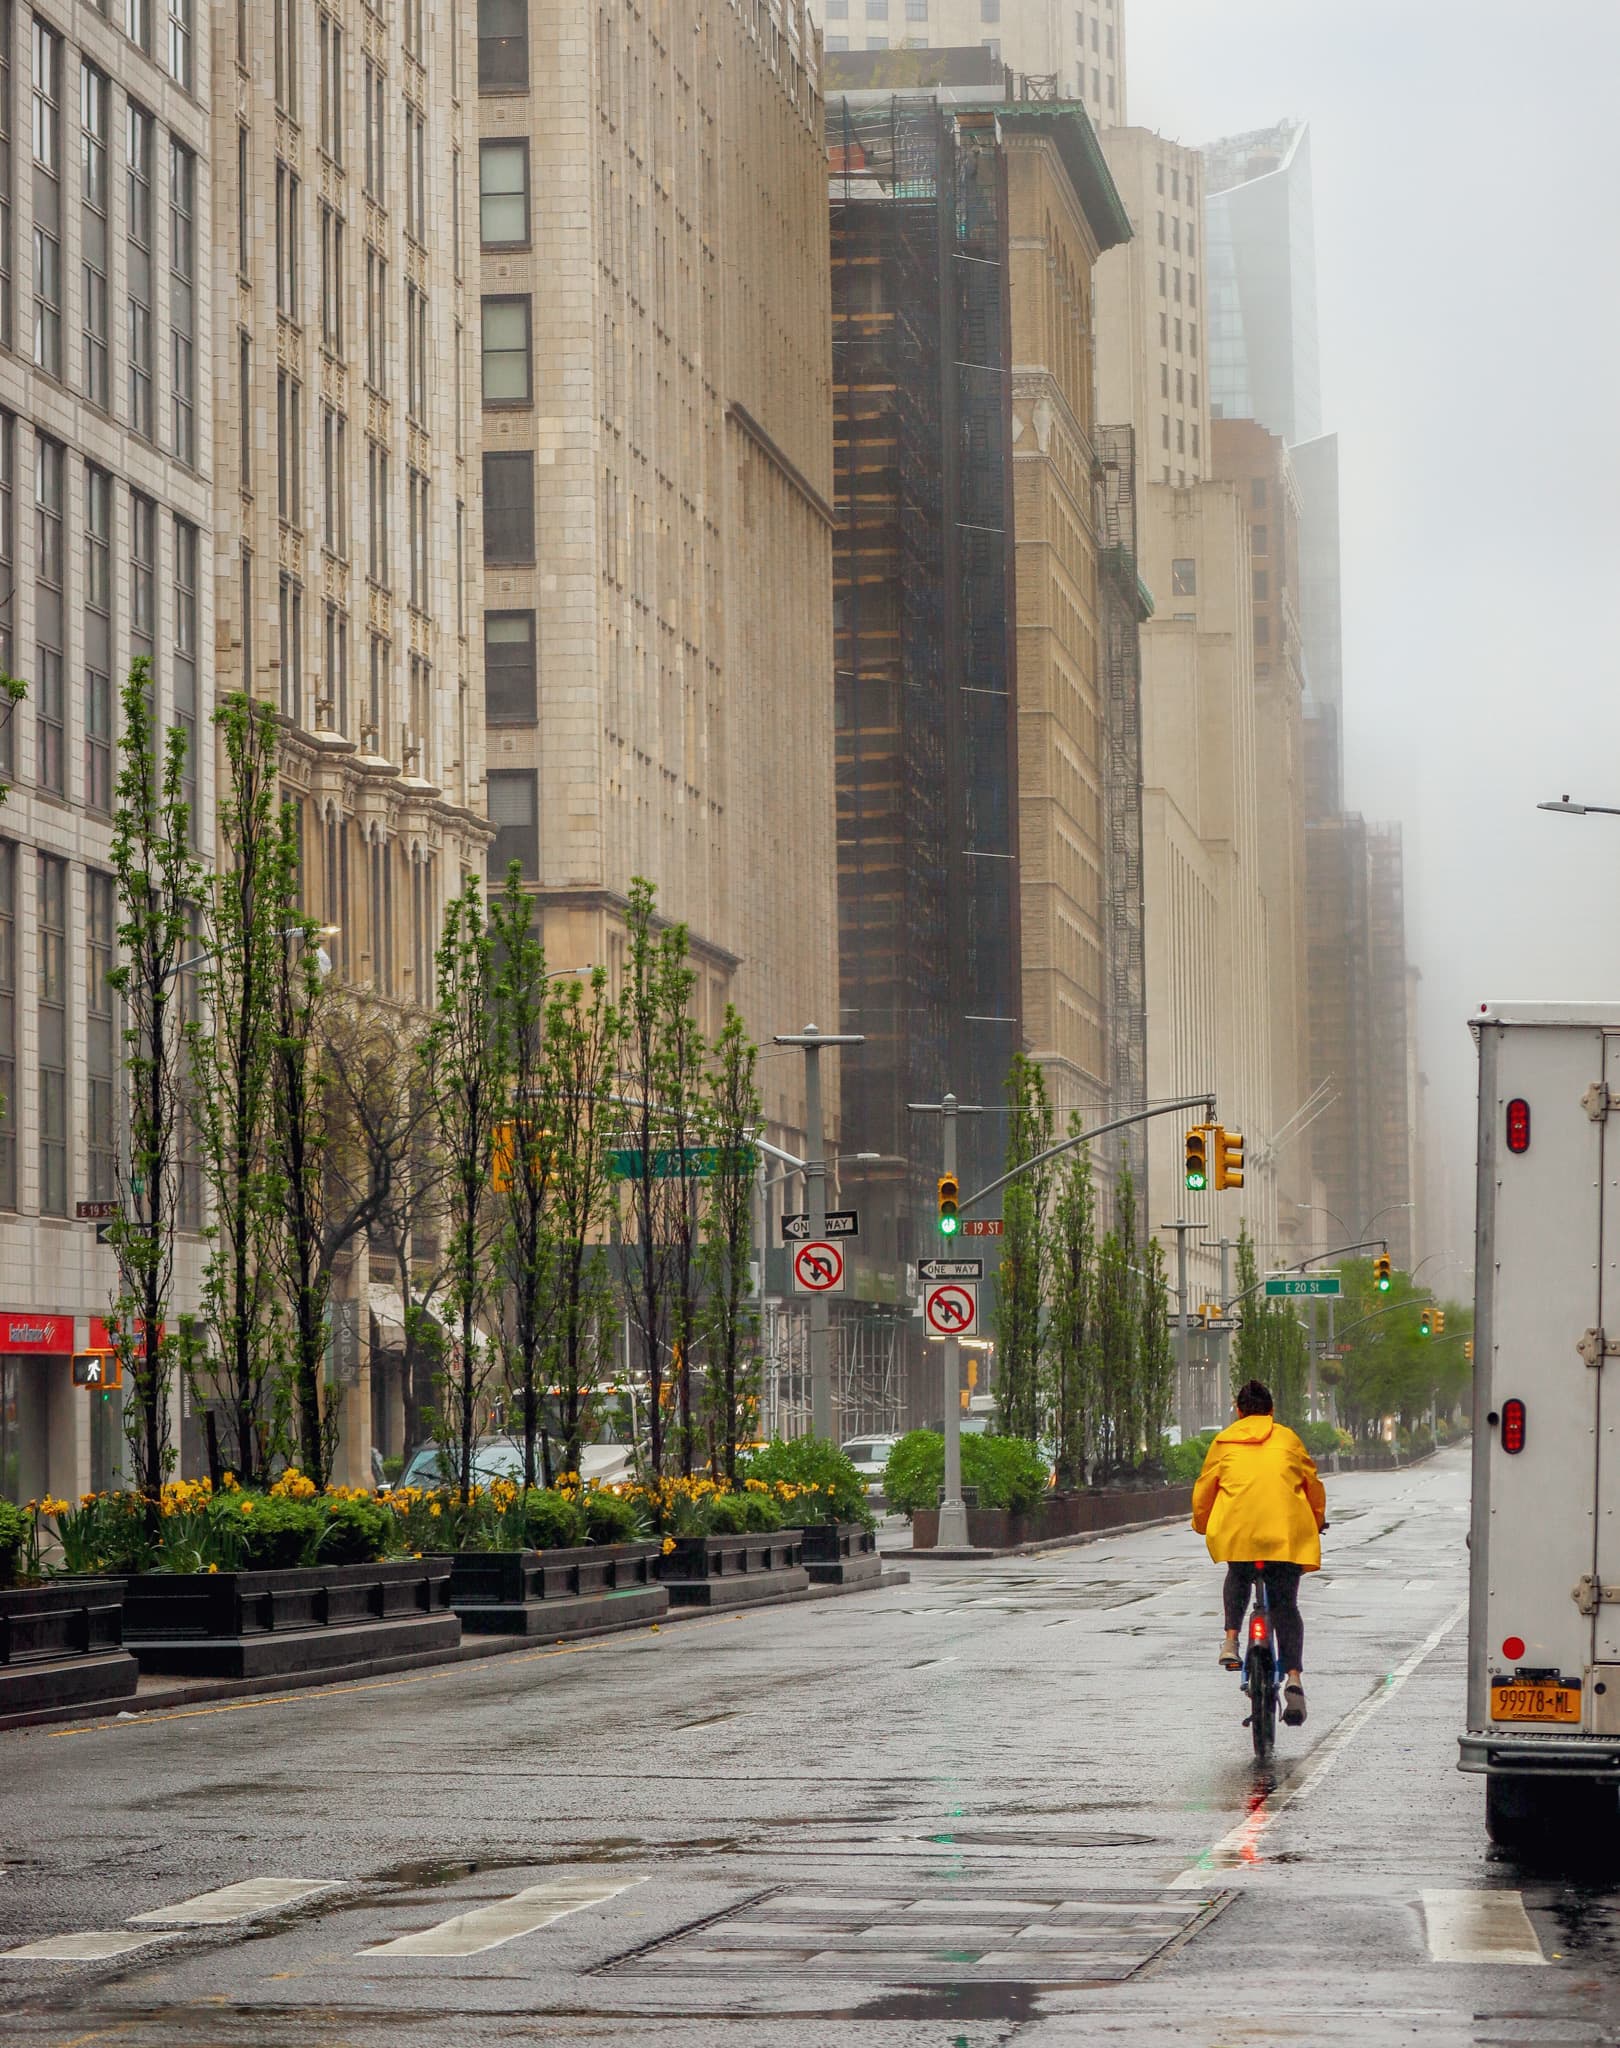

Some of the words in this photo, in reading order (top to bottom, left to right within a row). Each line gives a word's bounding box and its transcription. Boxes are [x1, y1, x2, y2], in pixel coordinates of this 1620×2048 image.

[81, 1204, 86, 1217] E
[90, 1204, 100, 1216] 19
[793, 1220, 810, 1232] ON
[963, 1222, 969, 1234] E
[974, 1221, 984, 1234] 19
[988, 1221, 1000, 1234] ST
[927, 1265, 946, 1274] ONE
[954, 1264, 975, 1274] WAY
[1285, 1282, 1291, 1293] E
[1294, 1282, 1307, 1293] 20
[1310, 1282, 1320, 1293] St
